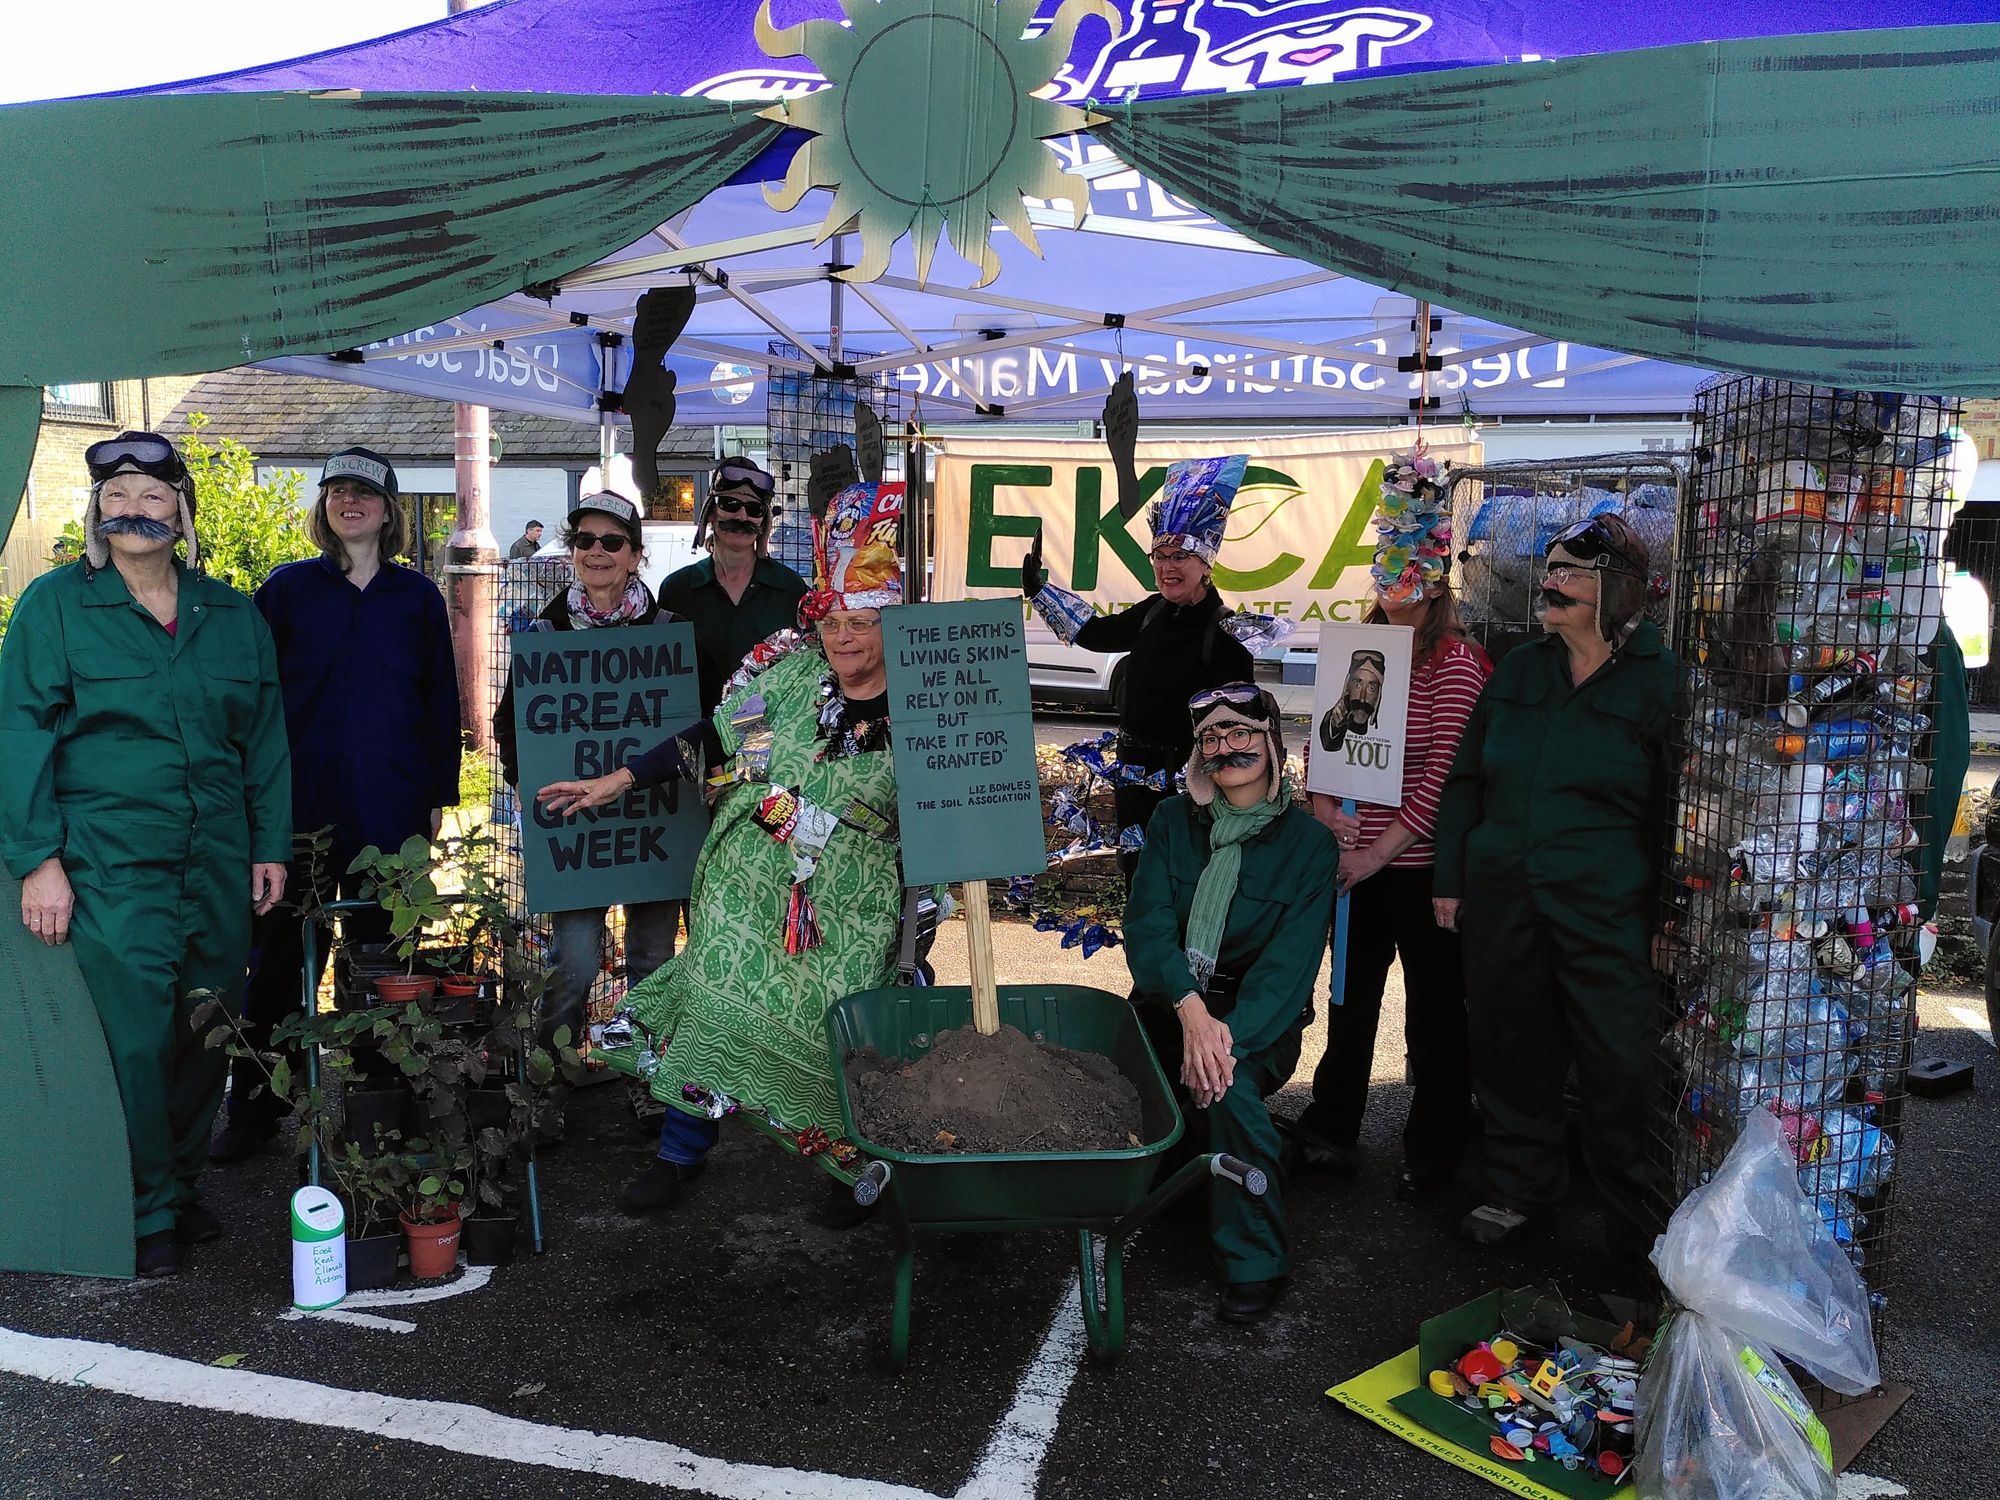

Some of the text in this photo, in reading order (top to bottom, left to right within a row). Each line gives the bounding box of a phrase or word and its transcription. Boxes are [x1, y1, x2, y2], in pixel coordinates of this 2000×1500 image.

[348, 458, 384, 479] CREW
[947, 621, 1016, 641] EARTH'S
[513, 641, 694, 688] NATIONAL
[900, 647, 961, 667] LIVING
[922, 668, 992, 688] WE ALL
[906, 688, 1002, 710] RELY ON IT,
[525, 689, 669, 735] GREAT
[937, 711, 969, 729] BUT
[905, 730, 1008, 752] TAKE IT FOR
[574, 737, 647, 780] BIG
[926, 748, 1009, 770] GRANTED"
[1344, 738, 1392, 770] YOU
[969, 780, 1032, 795] LIZ BOWLES
[763, 791, 791, 825] RAIDERS
[774, 797, 797, 825] SPACE
[916, 792, 1032, 811] THE SOIL ASSOCIATION
[547, 825, 670, 873] WEEK
[312, 1245, 333, 1256] East
[313, 1255, 334, 1266] Kent
[1375, 1411, 1405, 1432] FROM
[1406, 1431, 1416, 1439] 6
[1417, 1436, 1468, 1464] STREETS
[1476, 1465, 1520, 1489] NORTH
[1520, 1485, 1554, 1500] DEA
